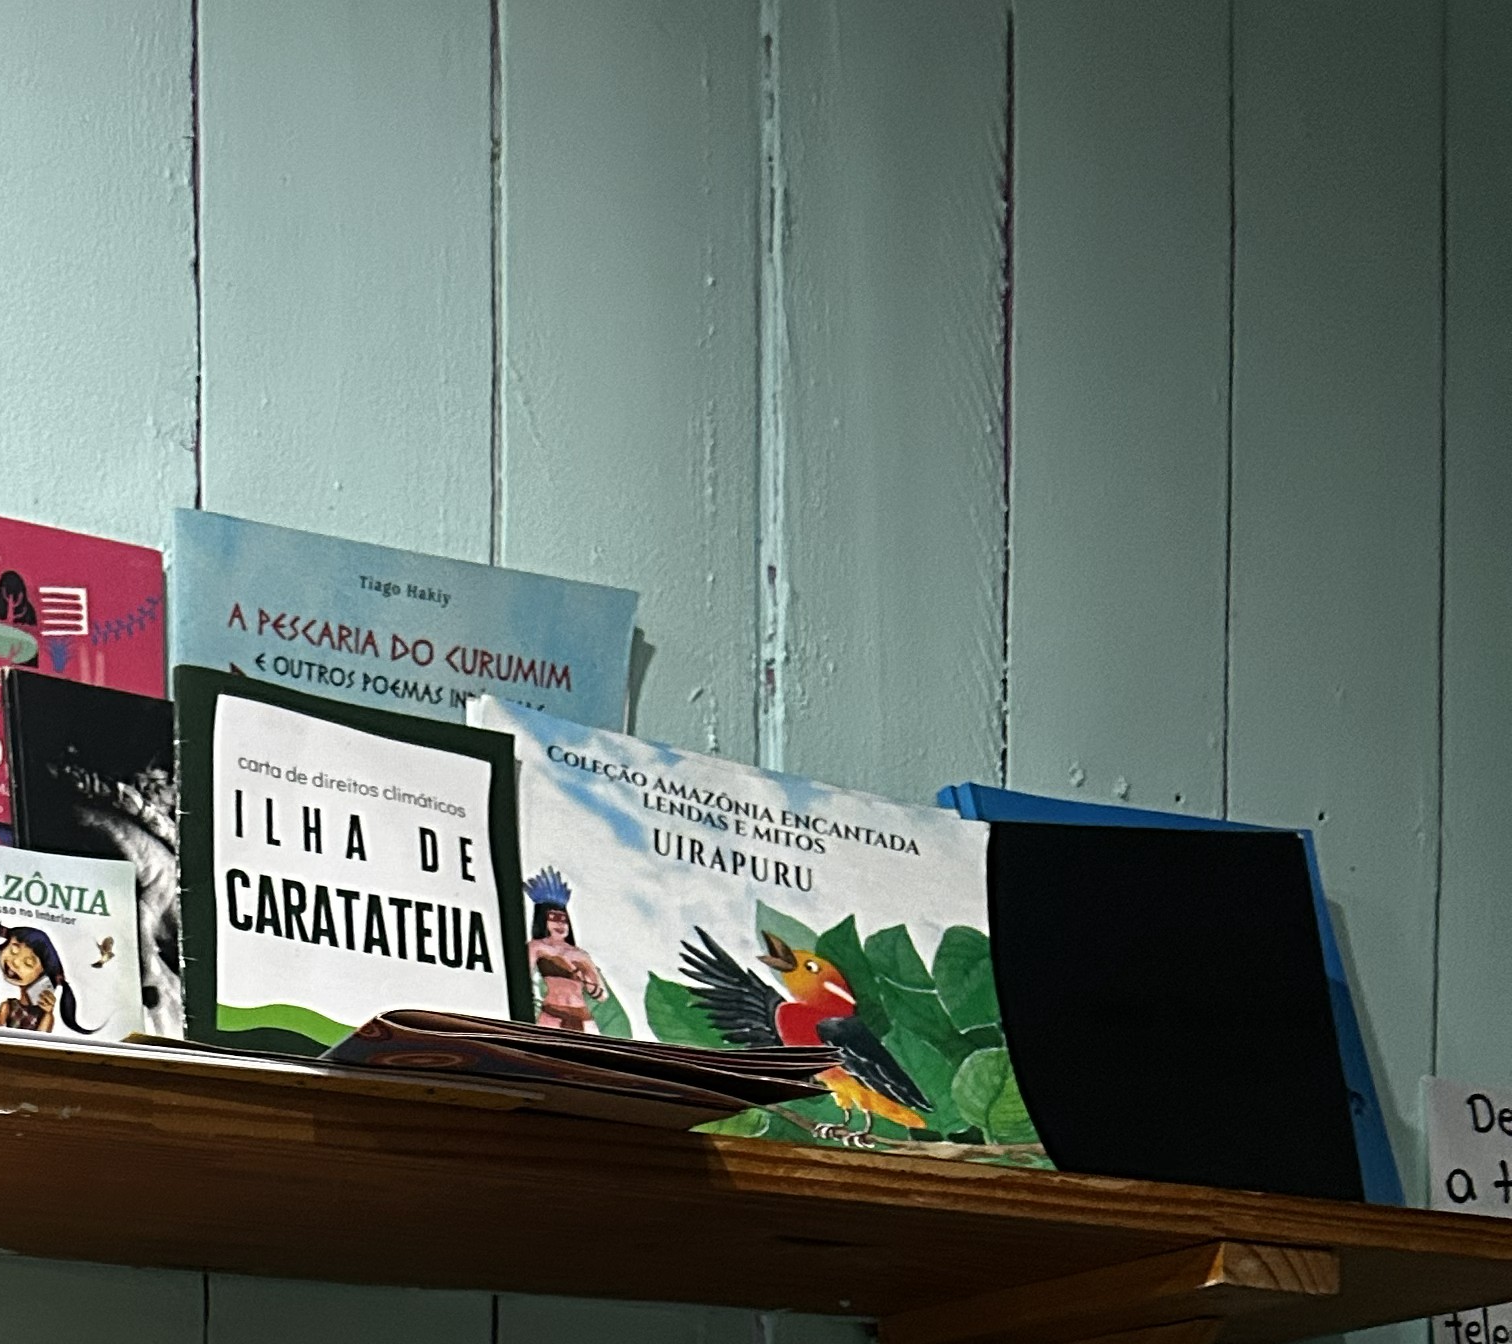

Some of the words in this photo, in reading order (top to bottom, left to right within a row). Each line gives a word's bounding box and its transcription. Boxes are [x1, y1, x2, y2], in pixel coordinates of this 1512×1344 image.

[359, 576, 401, 598] Tiago
[407, 583, 452, 608] Hakiy
[228, 602, 248, 632] A
[258, 607, 380, 658] PESCARIA
[390, 633, 434, 667] DO
[445, 645, 572, 692] CURUMIM
[255, 652, 266, 672] E
[273, 655, 355, 688] OUTROS
[361, 673, 443, 706] POEMAS
[238, 756, 282, 779] carta
[286, 766, 308, 784] de
[312, 772, 379, 798] direitos
[383, 785, 467, 818] climáticos
[547, 745, 648, 788] COLEÇÃO
[652, 777, 774, 825] AMAZÔNIA
[780, 811, 921, 856] ENCANTADA
[235, 789, 367, 861] ILHA
[419, 826, 476, 882] DE
[643, 793, 728, 831] LENDAS
[735, 820, 747, 838] E
[753, 826, 826, 856] MITOS
[653, 829, 813, 892] UIRAPURU
[19, 906, 34, 918] no
[226, 868, 494, 973] CARATATEUA
[1446, 1168, 1477, 1204] a
